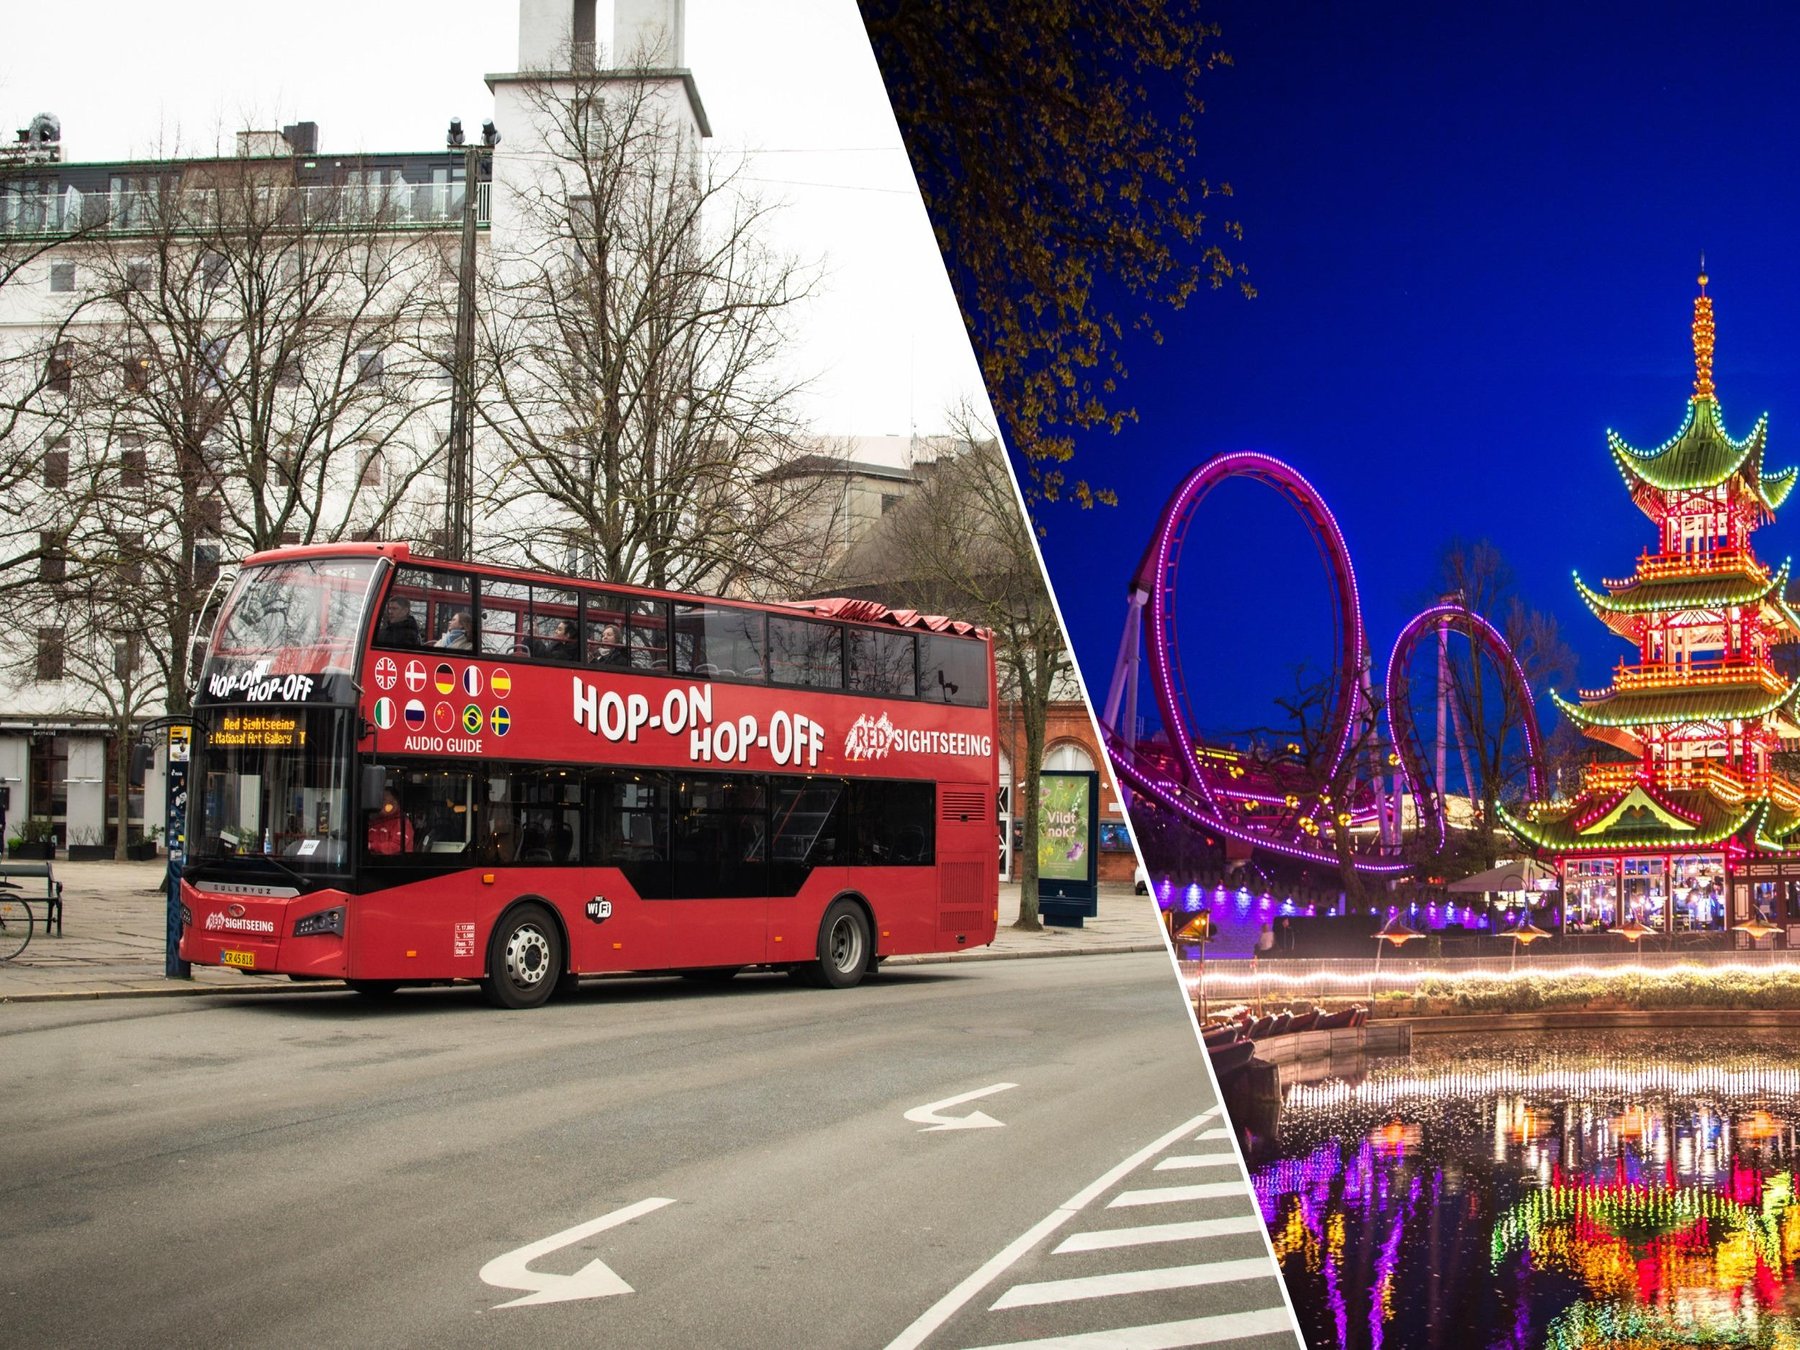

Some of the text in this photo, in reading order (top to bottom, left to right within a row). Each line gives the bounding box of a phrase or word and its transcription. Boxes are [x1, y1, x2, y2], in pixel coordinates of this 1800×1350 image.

[209, 659, 271, 698] HOP-ON
[246, 674, 314, 702] HOP-OFF
[573, 676, 713, 742] HOP-ON
[224, 718, 295, 730] Red Sightseeing
[216, 732, 246, 744] National
[248, 732, 262, 744] Art
[264, 732, 292, 744] Gallery
[404, 736, 482, 753] AUDIO GUIDE
[690, 710, 825, 767] HOP-OFF
[893, 729, 991, 757] SIGHTSEEING
[1047, 811, 1076, 823] Vildt
[1048, 826, 1077, 838] nok?
[225, 918, 274, 932] SIGHTSEEING
[225, 952, 253, 965] CR 45 818
